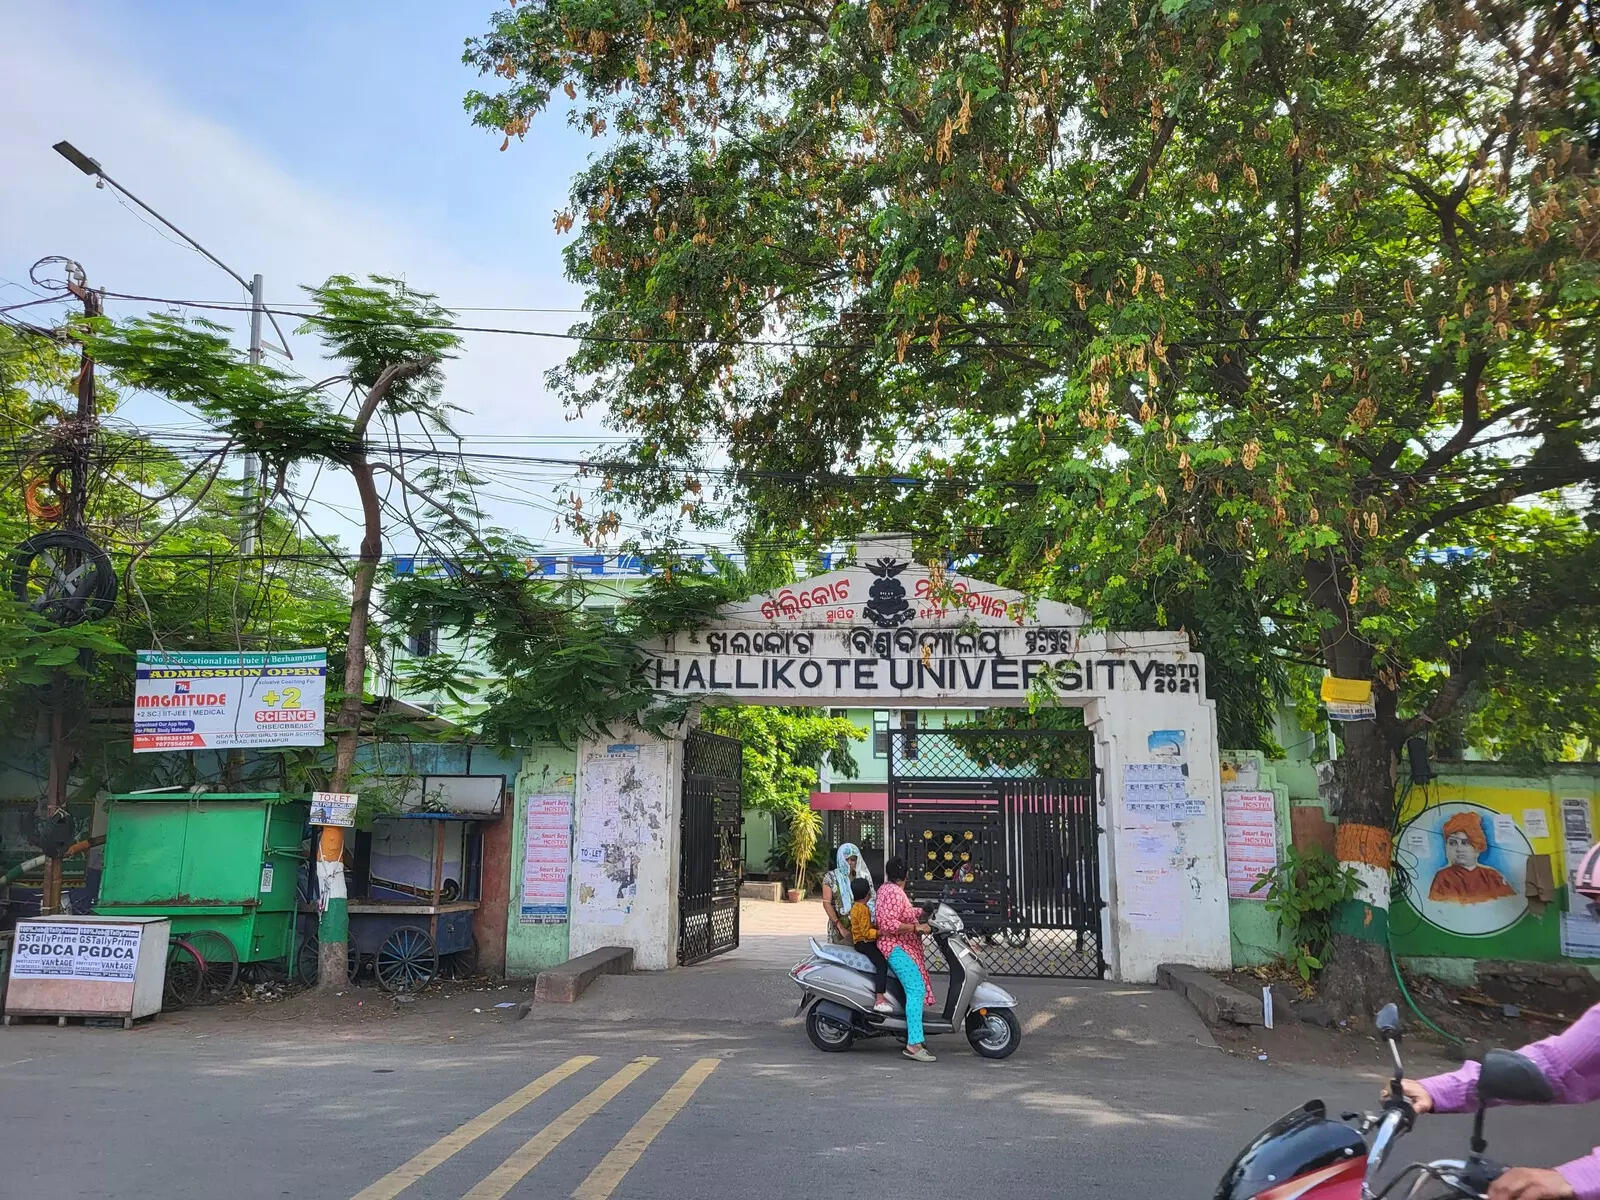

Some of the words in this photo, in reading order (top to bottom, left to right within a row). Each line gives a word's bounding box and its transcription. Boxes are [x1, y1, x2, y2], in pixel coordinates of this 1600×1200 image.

[223, 656, 257, 665] Insttute
[271, 655, 316, 664] Berhampur
[149, 668, 261, 679] ADMISSION
[266, 668, 320, 677] OPEN
[889, 658, 1157, 691] UNIVERSITY
[1154, 663, 1199, 678] ESTD
[1154, 678, 1199, 693] 2021
[136, 693, 226, 708] MAGNITUDE
[262, 687, 301, 709] +2
[256, 711, 315, 722] SCIENCE
[319, 793, 351, 803] TO-LET
[19, 934, 77, 944] GSTallyPrime
[79, 935, 138, 946] GSTallyPrime
[17, 943, 74, 956] PGDCA
[78, 945, 134, 959] PGDCA
